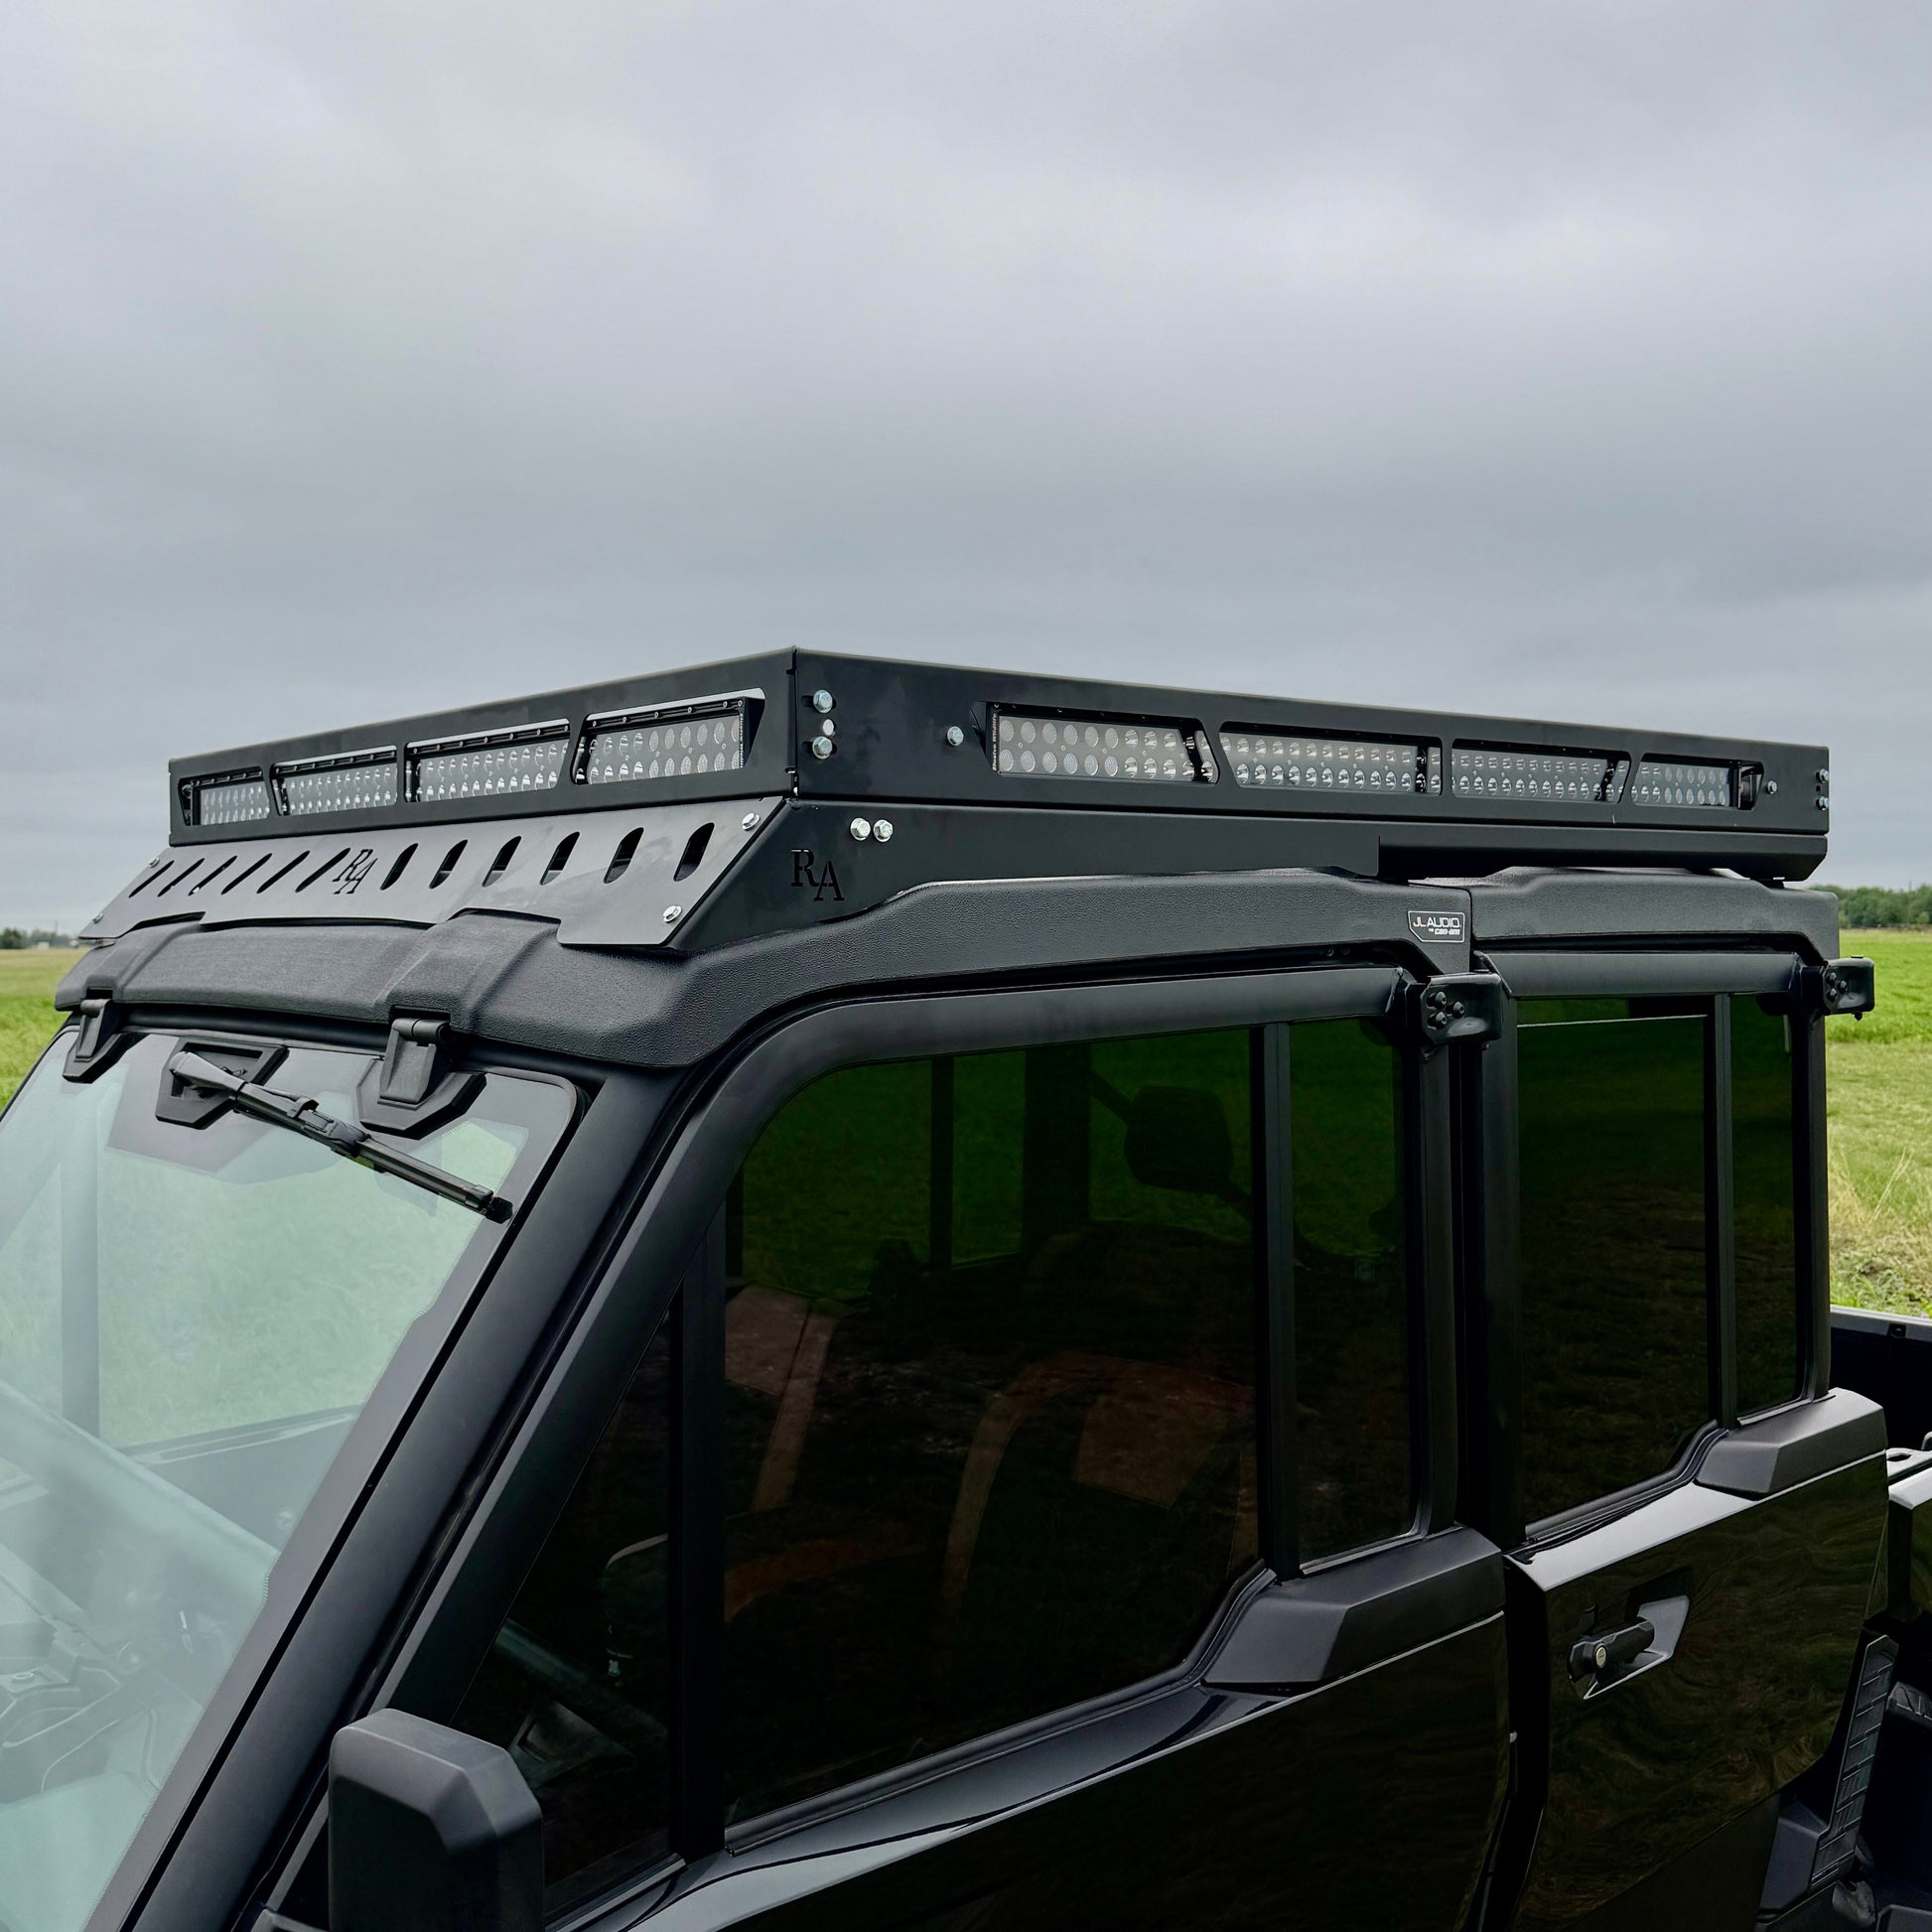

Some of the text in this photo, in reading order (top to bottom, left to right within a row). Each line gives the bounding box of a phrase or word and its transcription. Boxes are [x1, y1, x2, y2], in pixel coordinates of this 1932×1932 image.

[790, 849, 845, 901] RA
[1413, 916, 1460, 928] JL AUDIO
